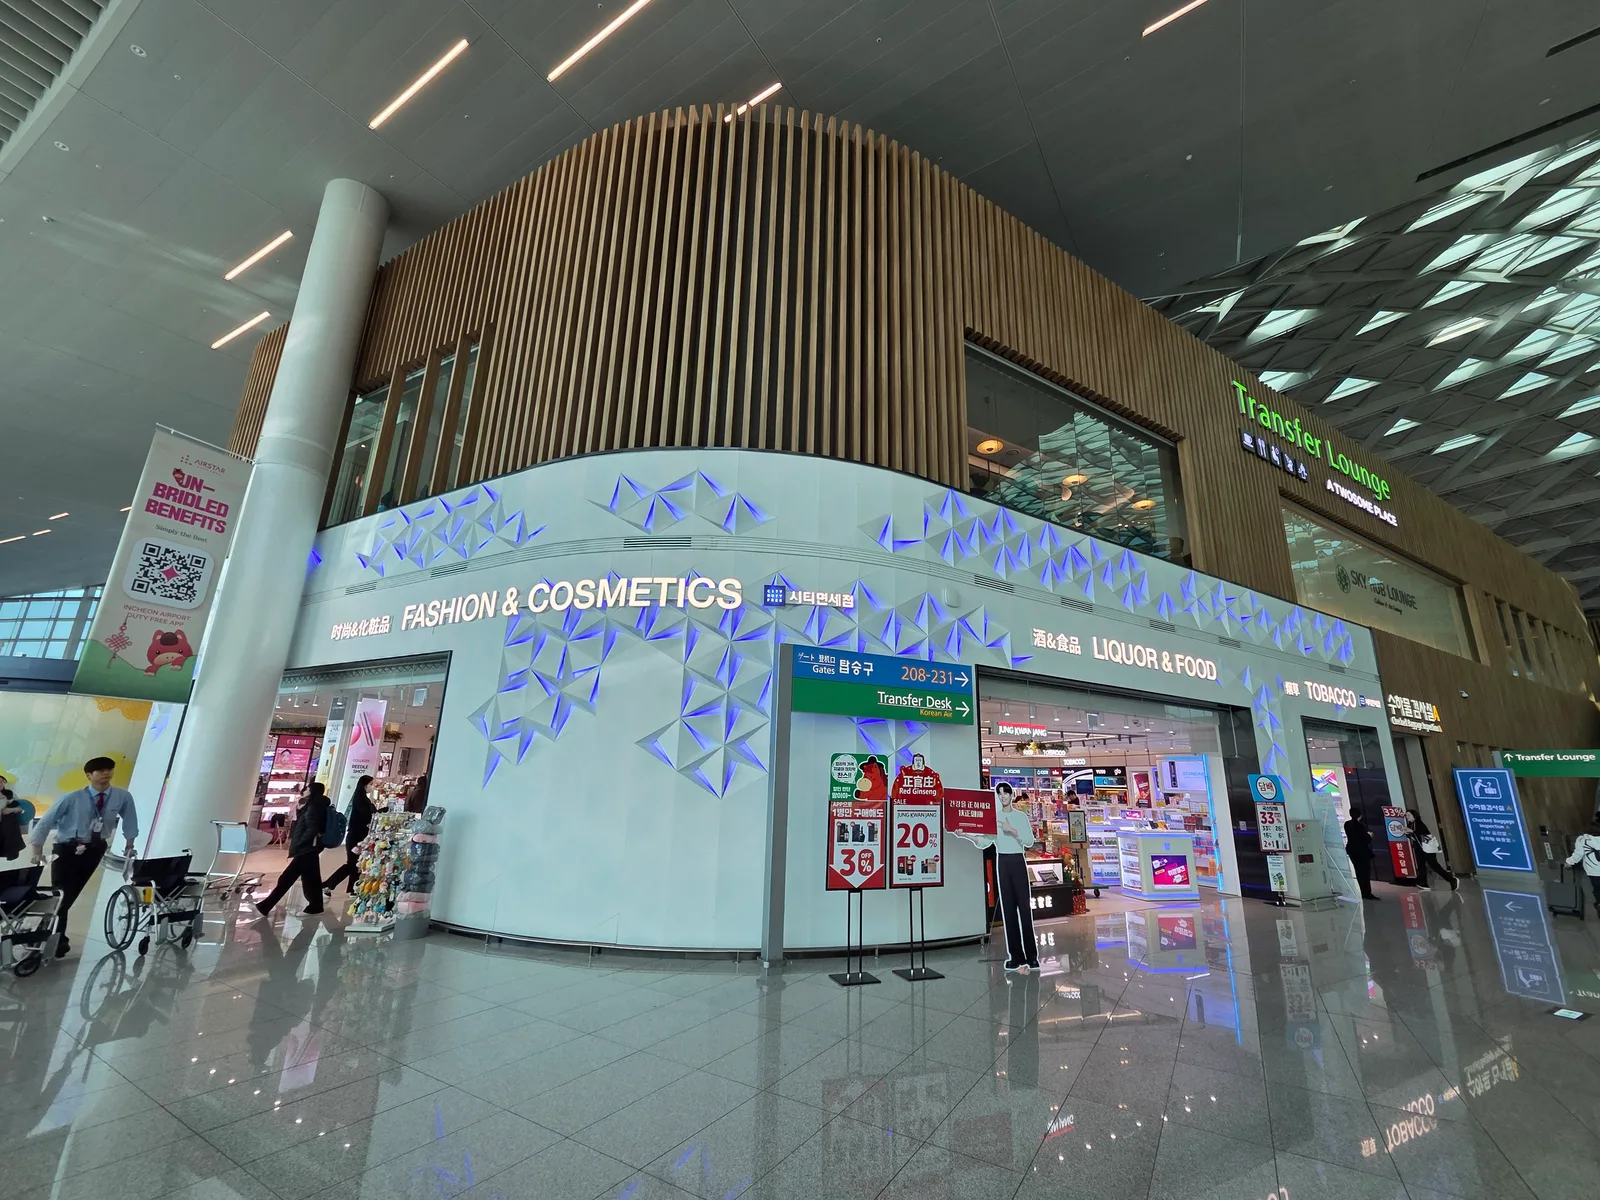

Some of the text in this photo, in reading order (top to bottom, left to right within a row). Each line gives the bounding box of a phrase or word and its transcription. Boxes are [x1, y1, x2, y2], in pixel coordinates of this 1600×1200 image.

[1231, 379, 1391, 501] Transfer Lounge
[194, 459, 226, 474] AIRSTAR
[152, 482, 229, 518] BRIDLED
[1332, 481, 1375, 514] TWOSOME
[1373, 504, 1398, 527] PLACE
[144, 498, 227, 534] BENEFITS
[155, 524, 179, 536] Simply
[193, 535, 208, 544] Best
[789, 590, 854, 608] 시티면세점
[1350, 570, 1368, 590] SKY
[1386, 584, 1418, 611] LOUNGE
[123, 604, 192, 621] INCHEON AIRPORT
[401, 577, 743, 631] FASHION & COSMETICS
[1032, 628, 1082, 655] 酒&食品
[1091, 636, 1217, 681] LIQUOR & FOOD
[812, 664, 836, 675] Gates
[839, 659, 874, 677] 탑승구
[901, 666, 953, 685] 208-231
[877, 691, 952, 709] Transfer Desk
[1303, 680, 1357, 708] TOBACCO
[920, 709, 942, 717] Korean
[998, 726, 1047, 738] JUNG KWAN JANG
[1515, 753, 1596, 762] Transfer Lounge
[902, 775, 934, 788] 正官庄
[899, 787, 937, 797] Red Ginseng
[1259, 811, 1275, 825] 33
[1383, 808, 1405, 817] 33%
[896, 822, 930, 849] 20
[928, 839, 938, 849] %
[860, 859, 873, 873] %
